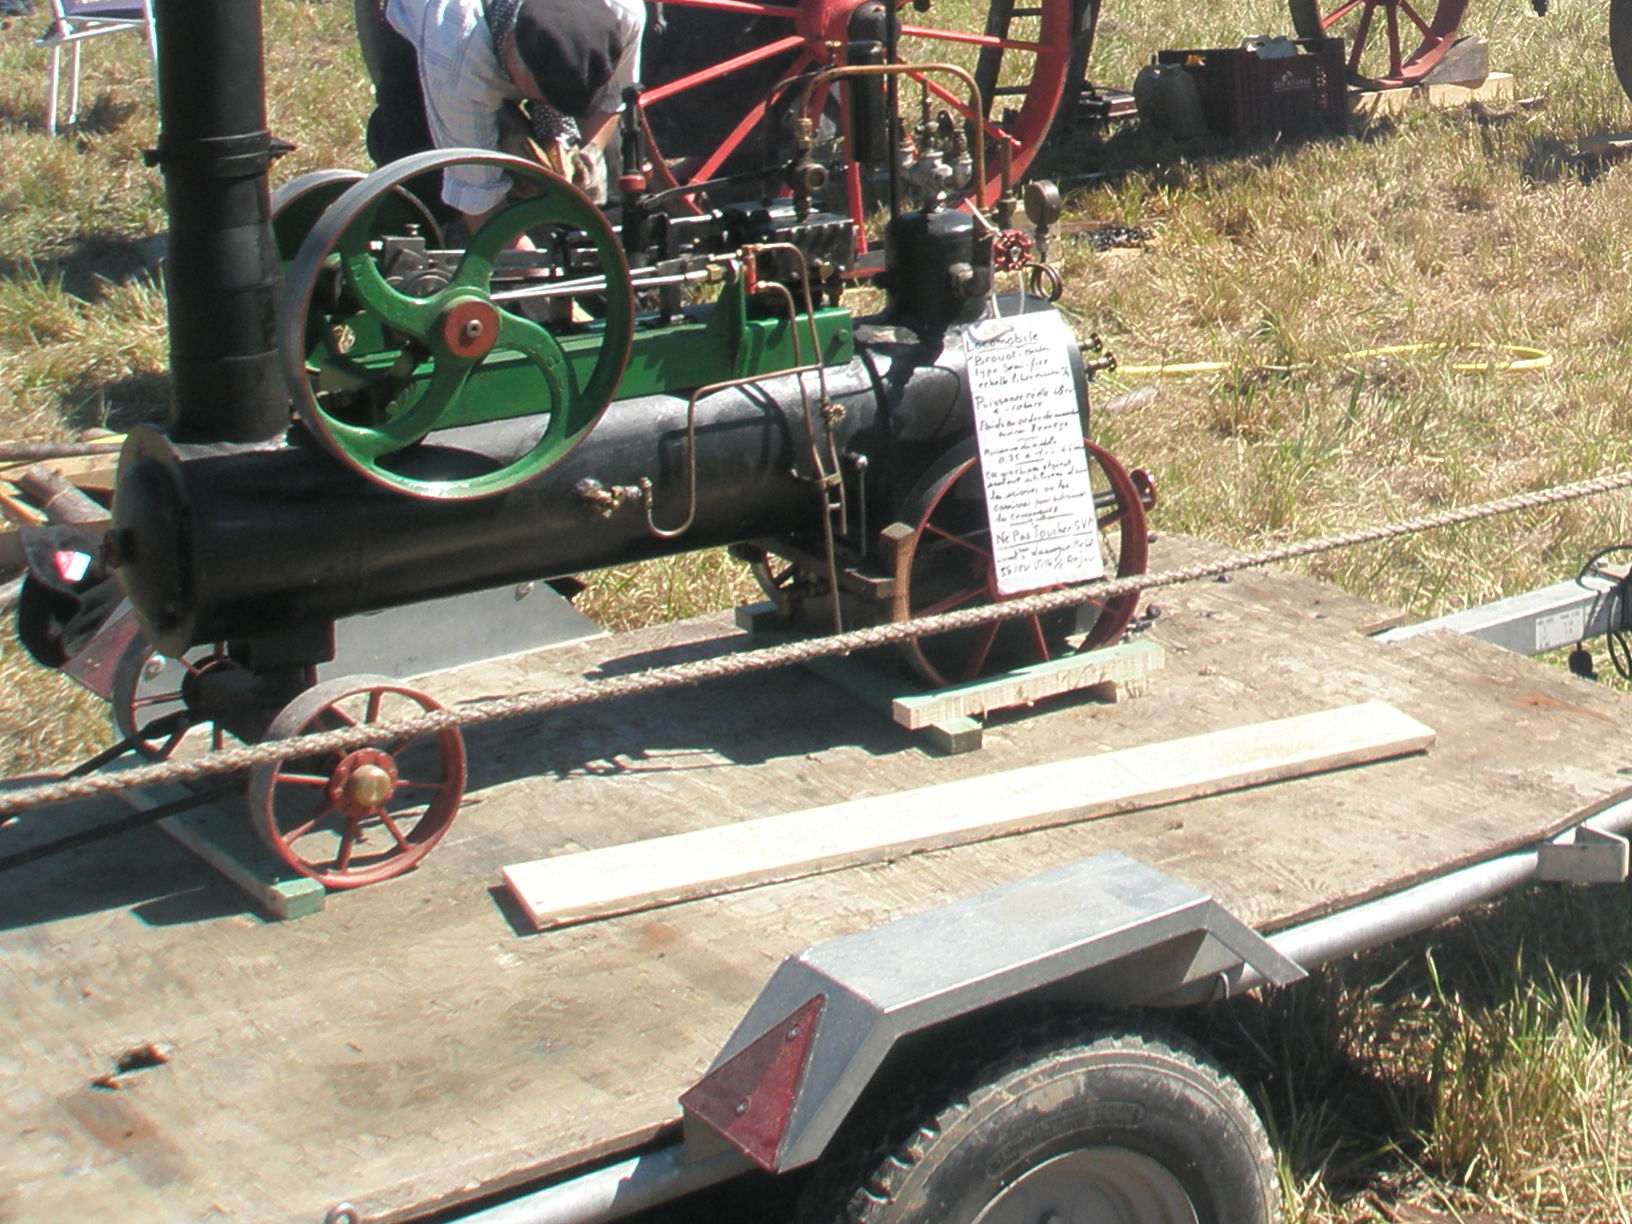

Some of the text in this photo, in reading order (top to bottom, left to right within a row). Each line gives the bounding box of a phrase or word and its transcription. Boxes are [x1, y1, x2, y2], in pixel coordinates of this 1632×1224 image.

[966, 330, 1039, 353] Locomobile
[996, 516, 1095, 545] Ne Pas Toucher SVP
